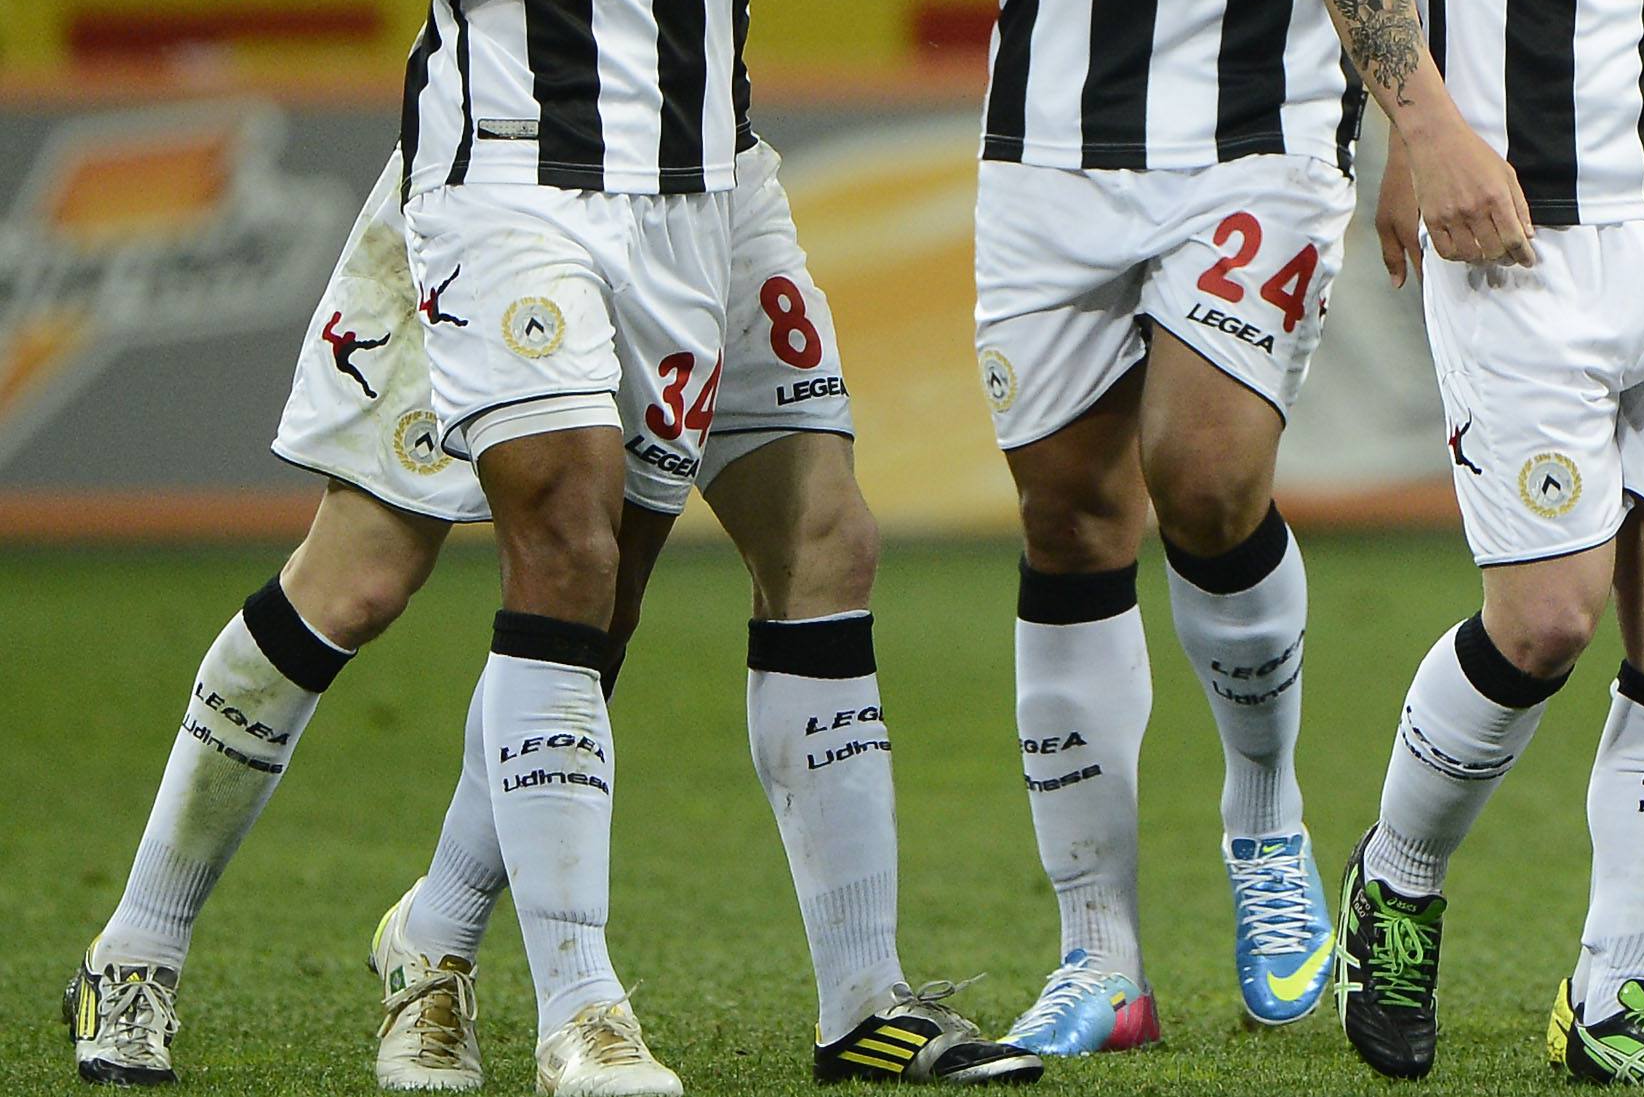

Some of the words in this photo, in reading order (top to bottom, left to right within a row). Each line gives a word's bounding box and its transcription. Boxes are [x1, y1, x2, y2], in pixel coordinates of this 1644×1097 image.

[1197, 211, 1319, 333] 24
[760, 275, 822, 369] 8
[1187, 304, 1275, 354] LEGEA
[645, 348, 722, 448] 34
[195, 682, 290, 746] LEGEA
[805, 706, 884, 736] LEG
[807, 740, 892, 770] Udine
